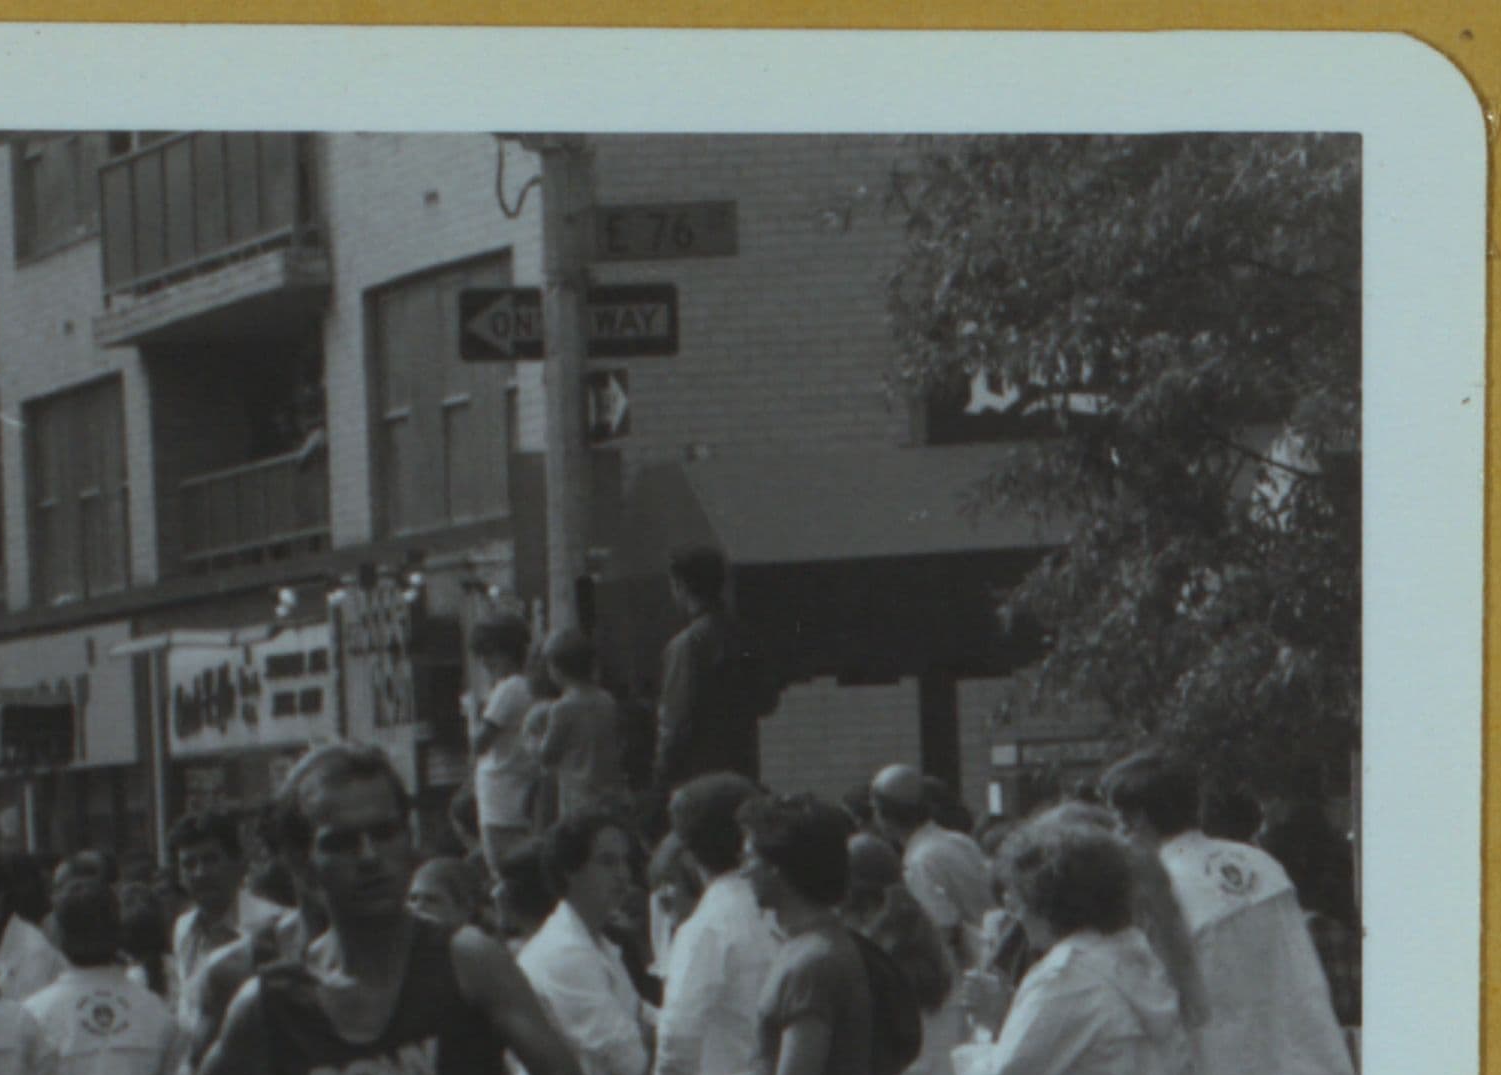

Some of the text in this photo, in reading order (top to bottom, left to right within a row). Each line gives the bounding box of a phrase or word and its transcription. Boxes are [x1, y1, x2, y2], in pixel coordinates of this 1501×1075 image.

[604, 213, 629, 253] E
[646, 209, 693, 253] 76
[595, 307, 660, 336] WAY
